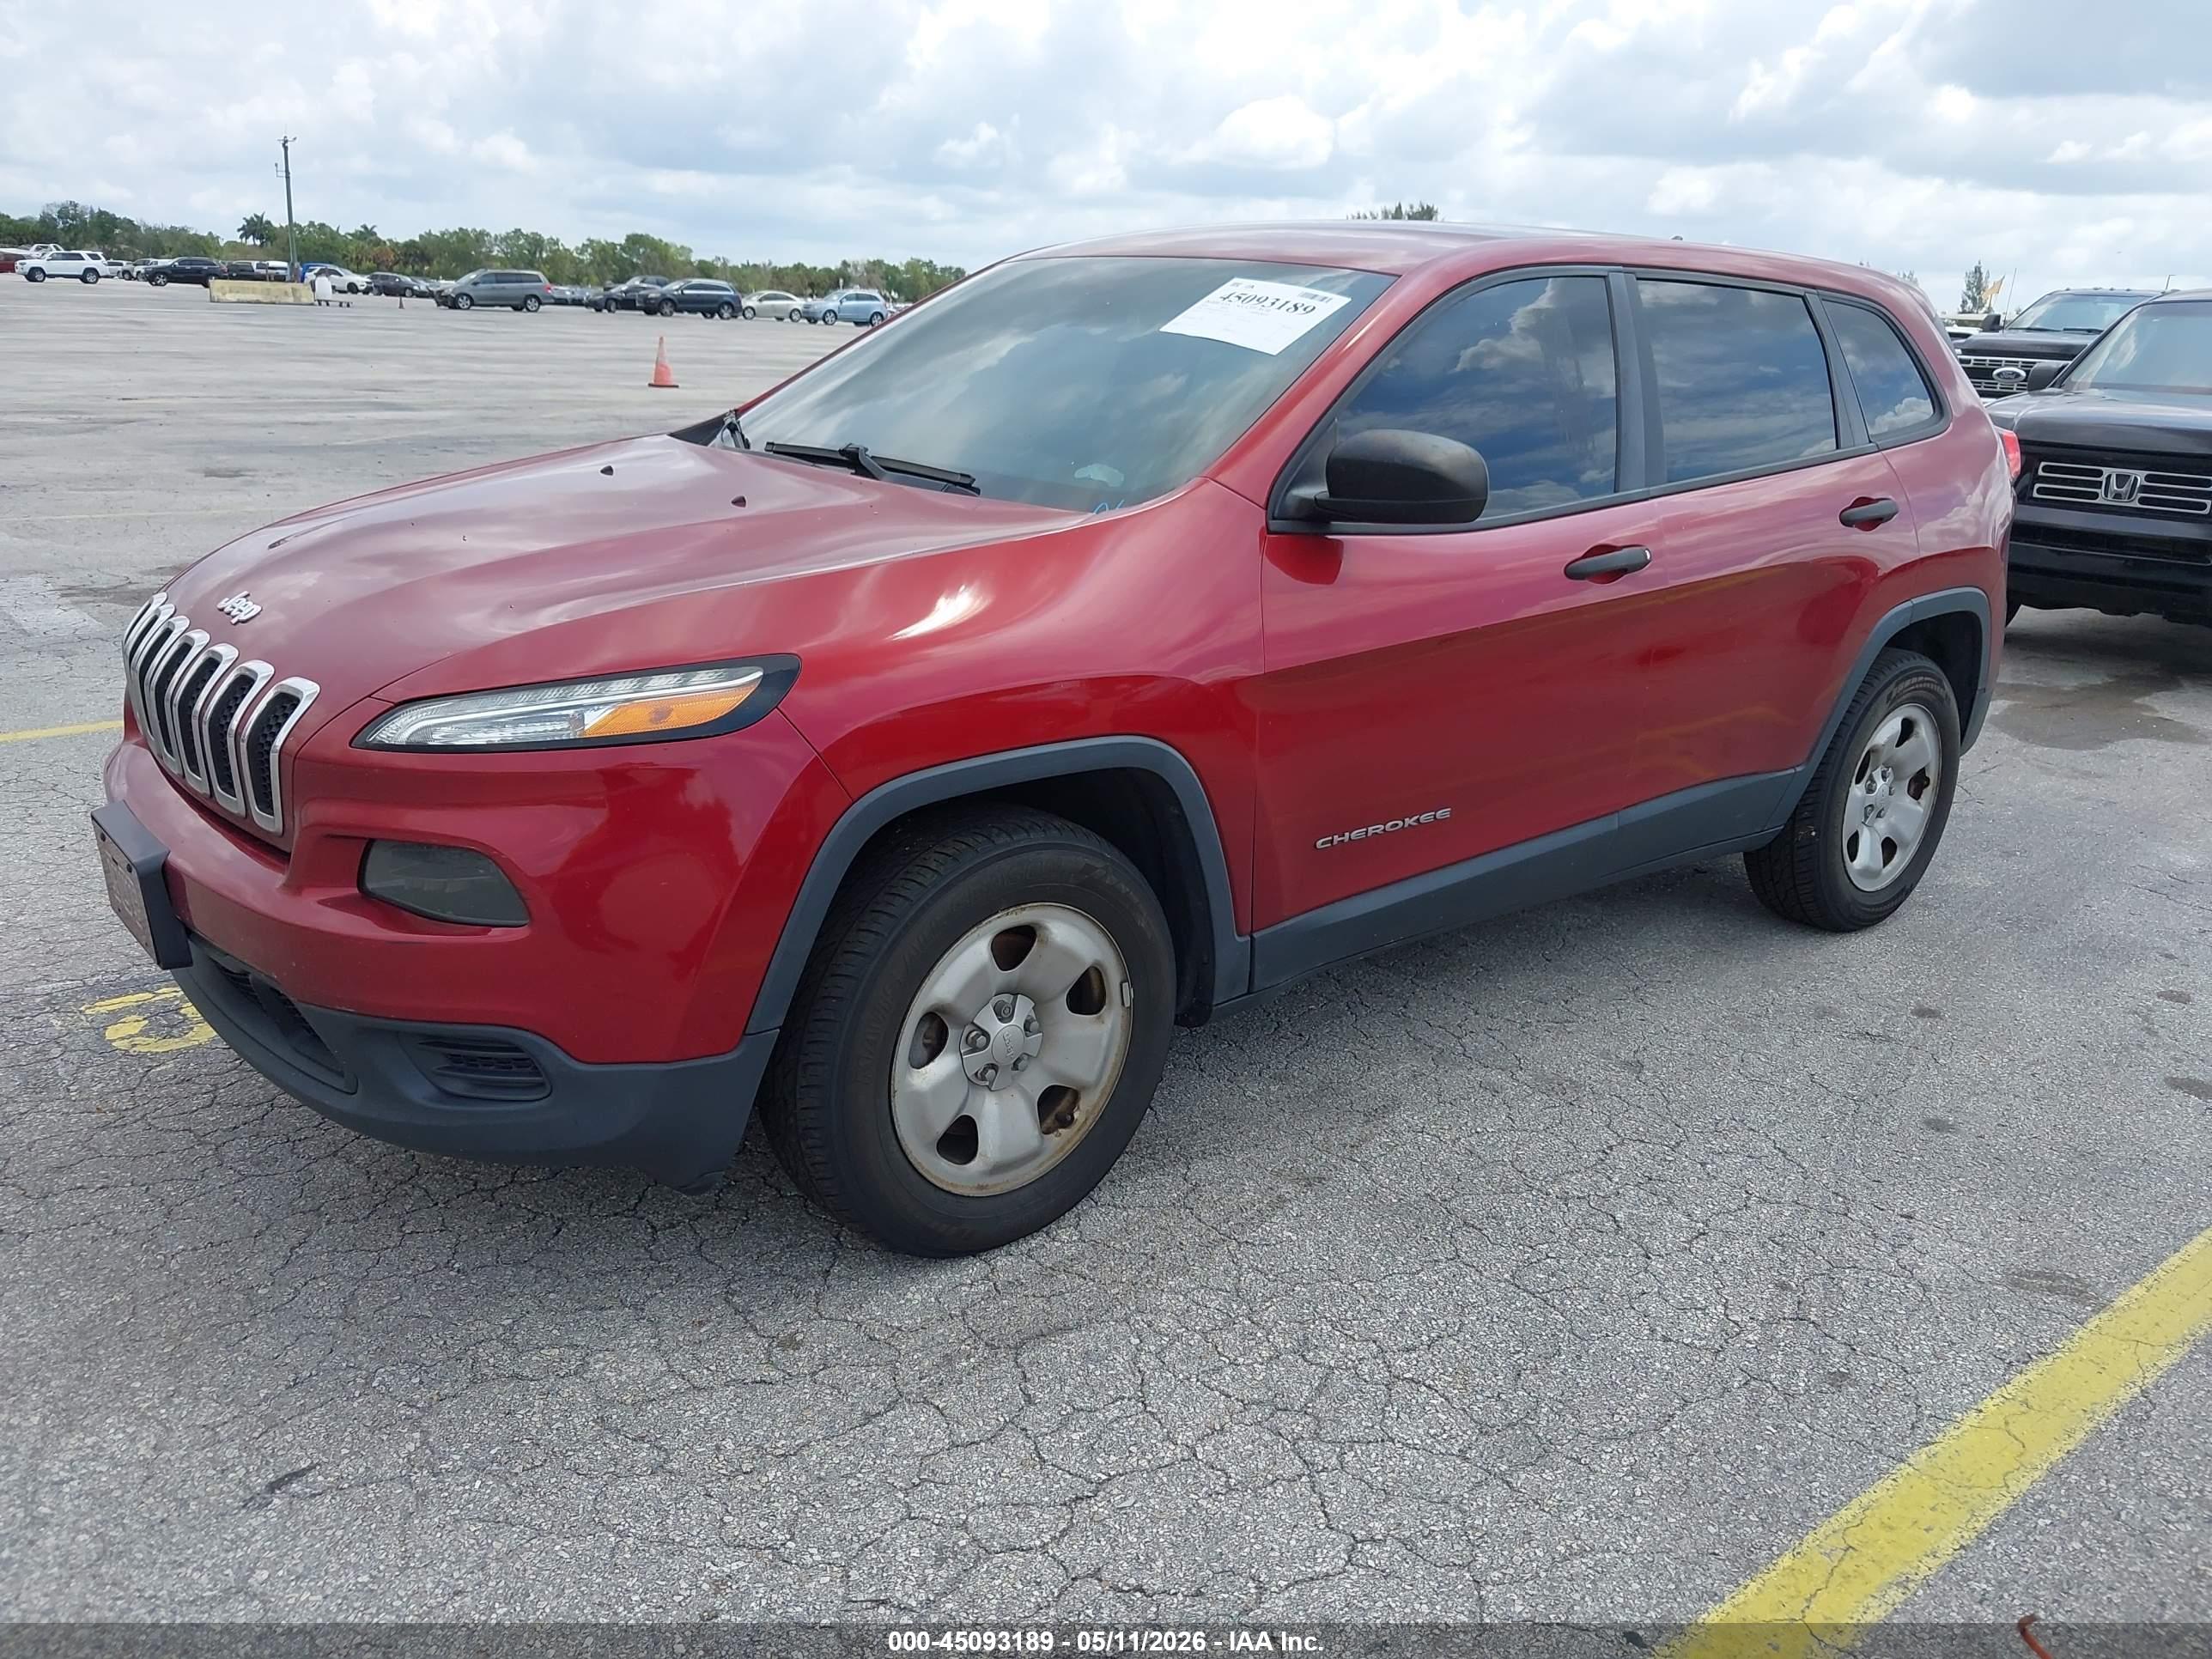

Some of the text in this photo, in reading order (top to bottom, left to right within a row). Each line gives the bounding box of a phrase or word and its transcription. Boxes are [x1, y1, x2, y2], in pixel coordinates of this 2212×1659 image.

[1218, 290, 1316, 316] 45093189
[216, 591, 262, 625] Jeep
[1316, 808, 1452, 849] CHEROKEE
